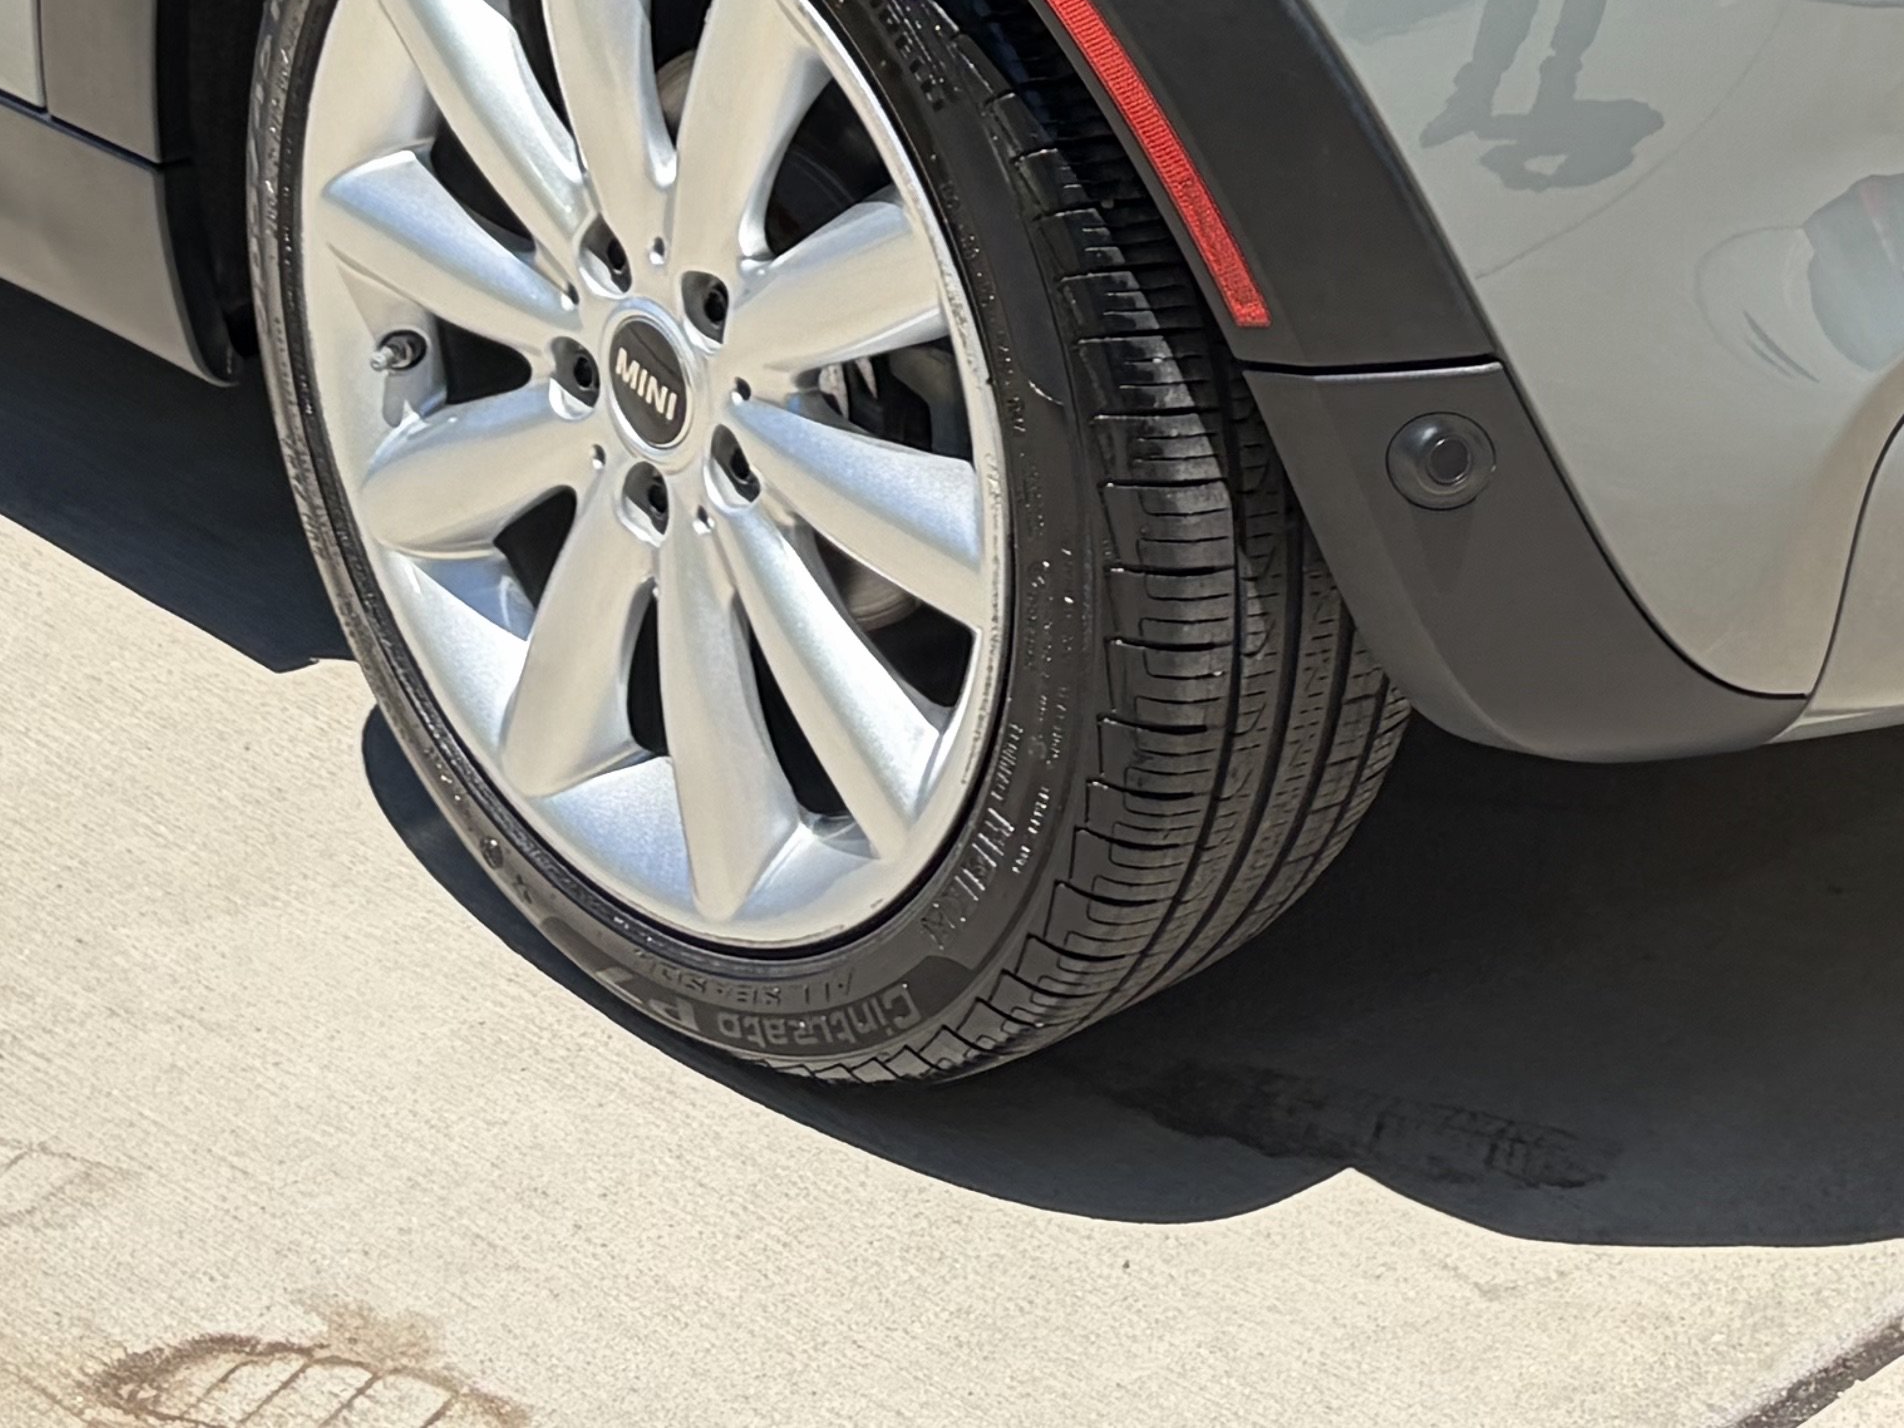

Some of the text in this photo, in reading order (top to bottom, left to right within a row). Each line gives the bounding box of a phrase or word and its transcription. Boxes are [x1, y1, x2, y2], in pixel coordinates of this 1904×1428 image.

[615, 346, 678, 421] MINI
[595, 964, 921, 1052] Cinturato P7
